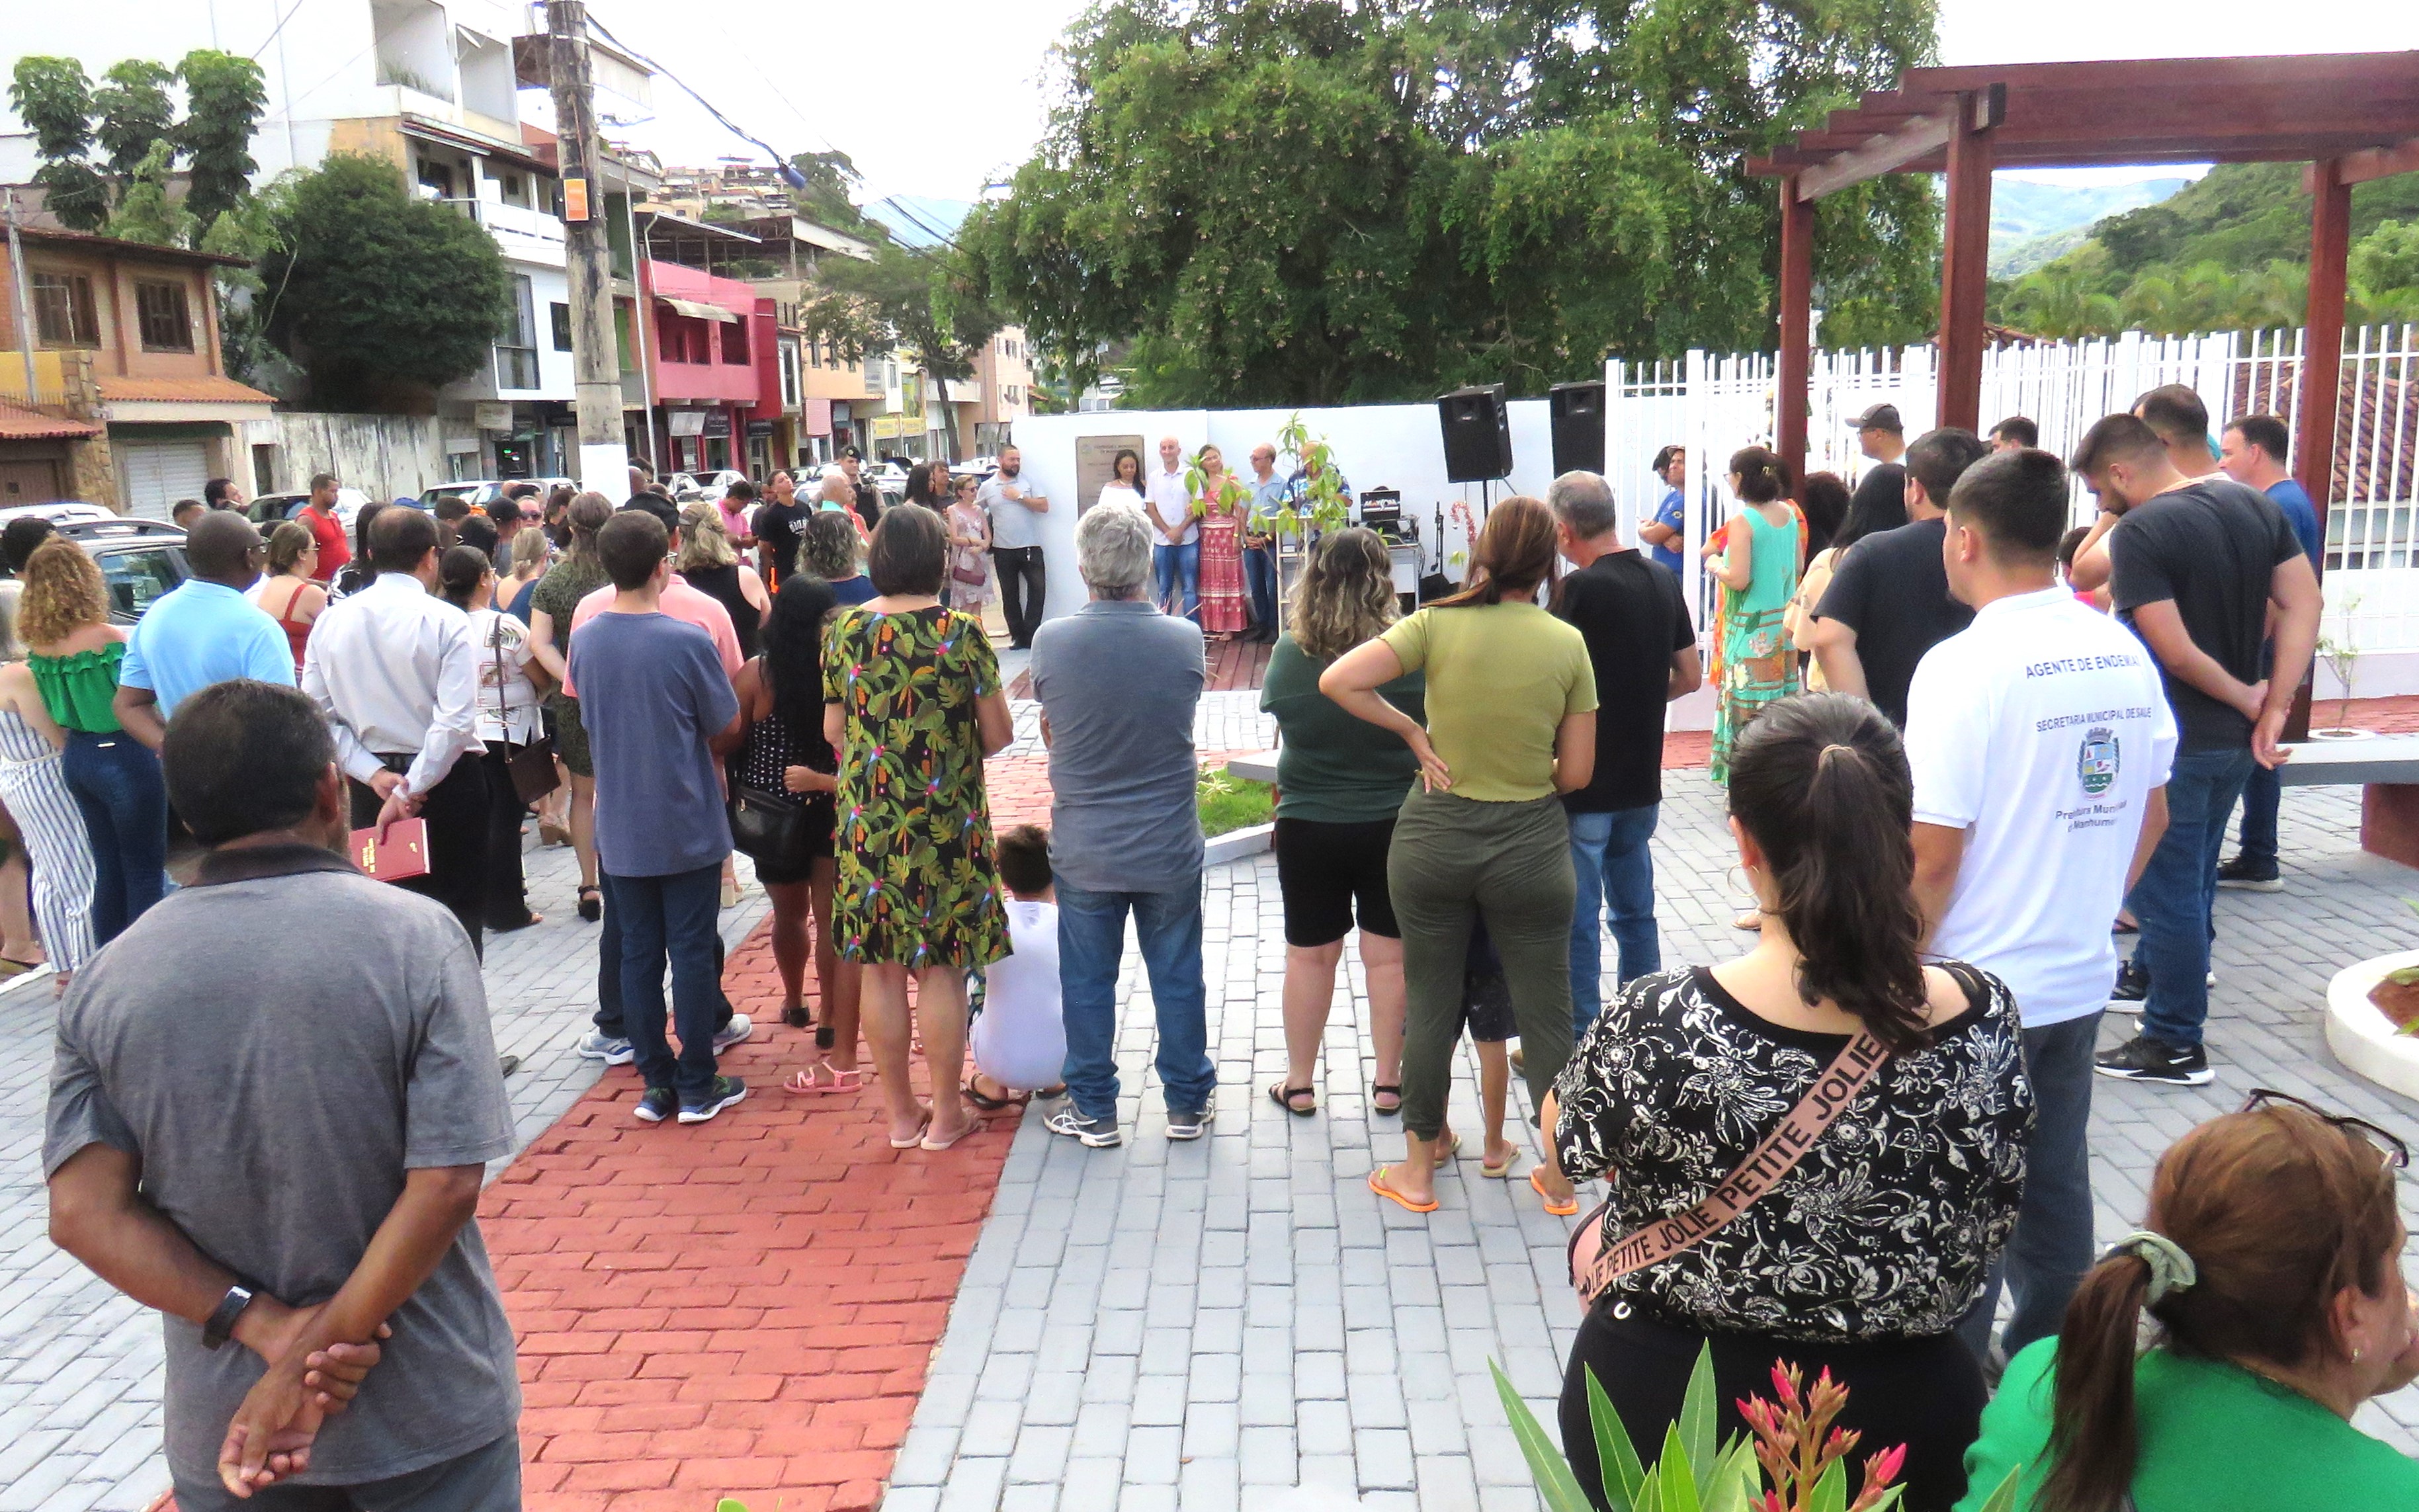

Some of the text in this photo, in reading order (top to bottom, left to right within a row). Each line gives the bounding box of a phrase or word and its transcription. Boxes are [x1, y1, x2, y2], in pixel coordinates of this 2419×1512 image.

[2025, 659, 2076, 679] AGENTE
[2077, 657, 2094, 671] DE
[2035, 714, 2086, 732] SECRETARIA
[1606, 1234, 1654, 1279] PETITE
[1658, 1208, 1719, 1252] JOLIE
[1721, 1122, 1812, 1210] PETITE
[1816, 1032, 1884, 1121] JOLIE
